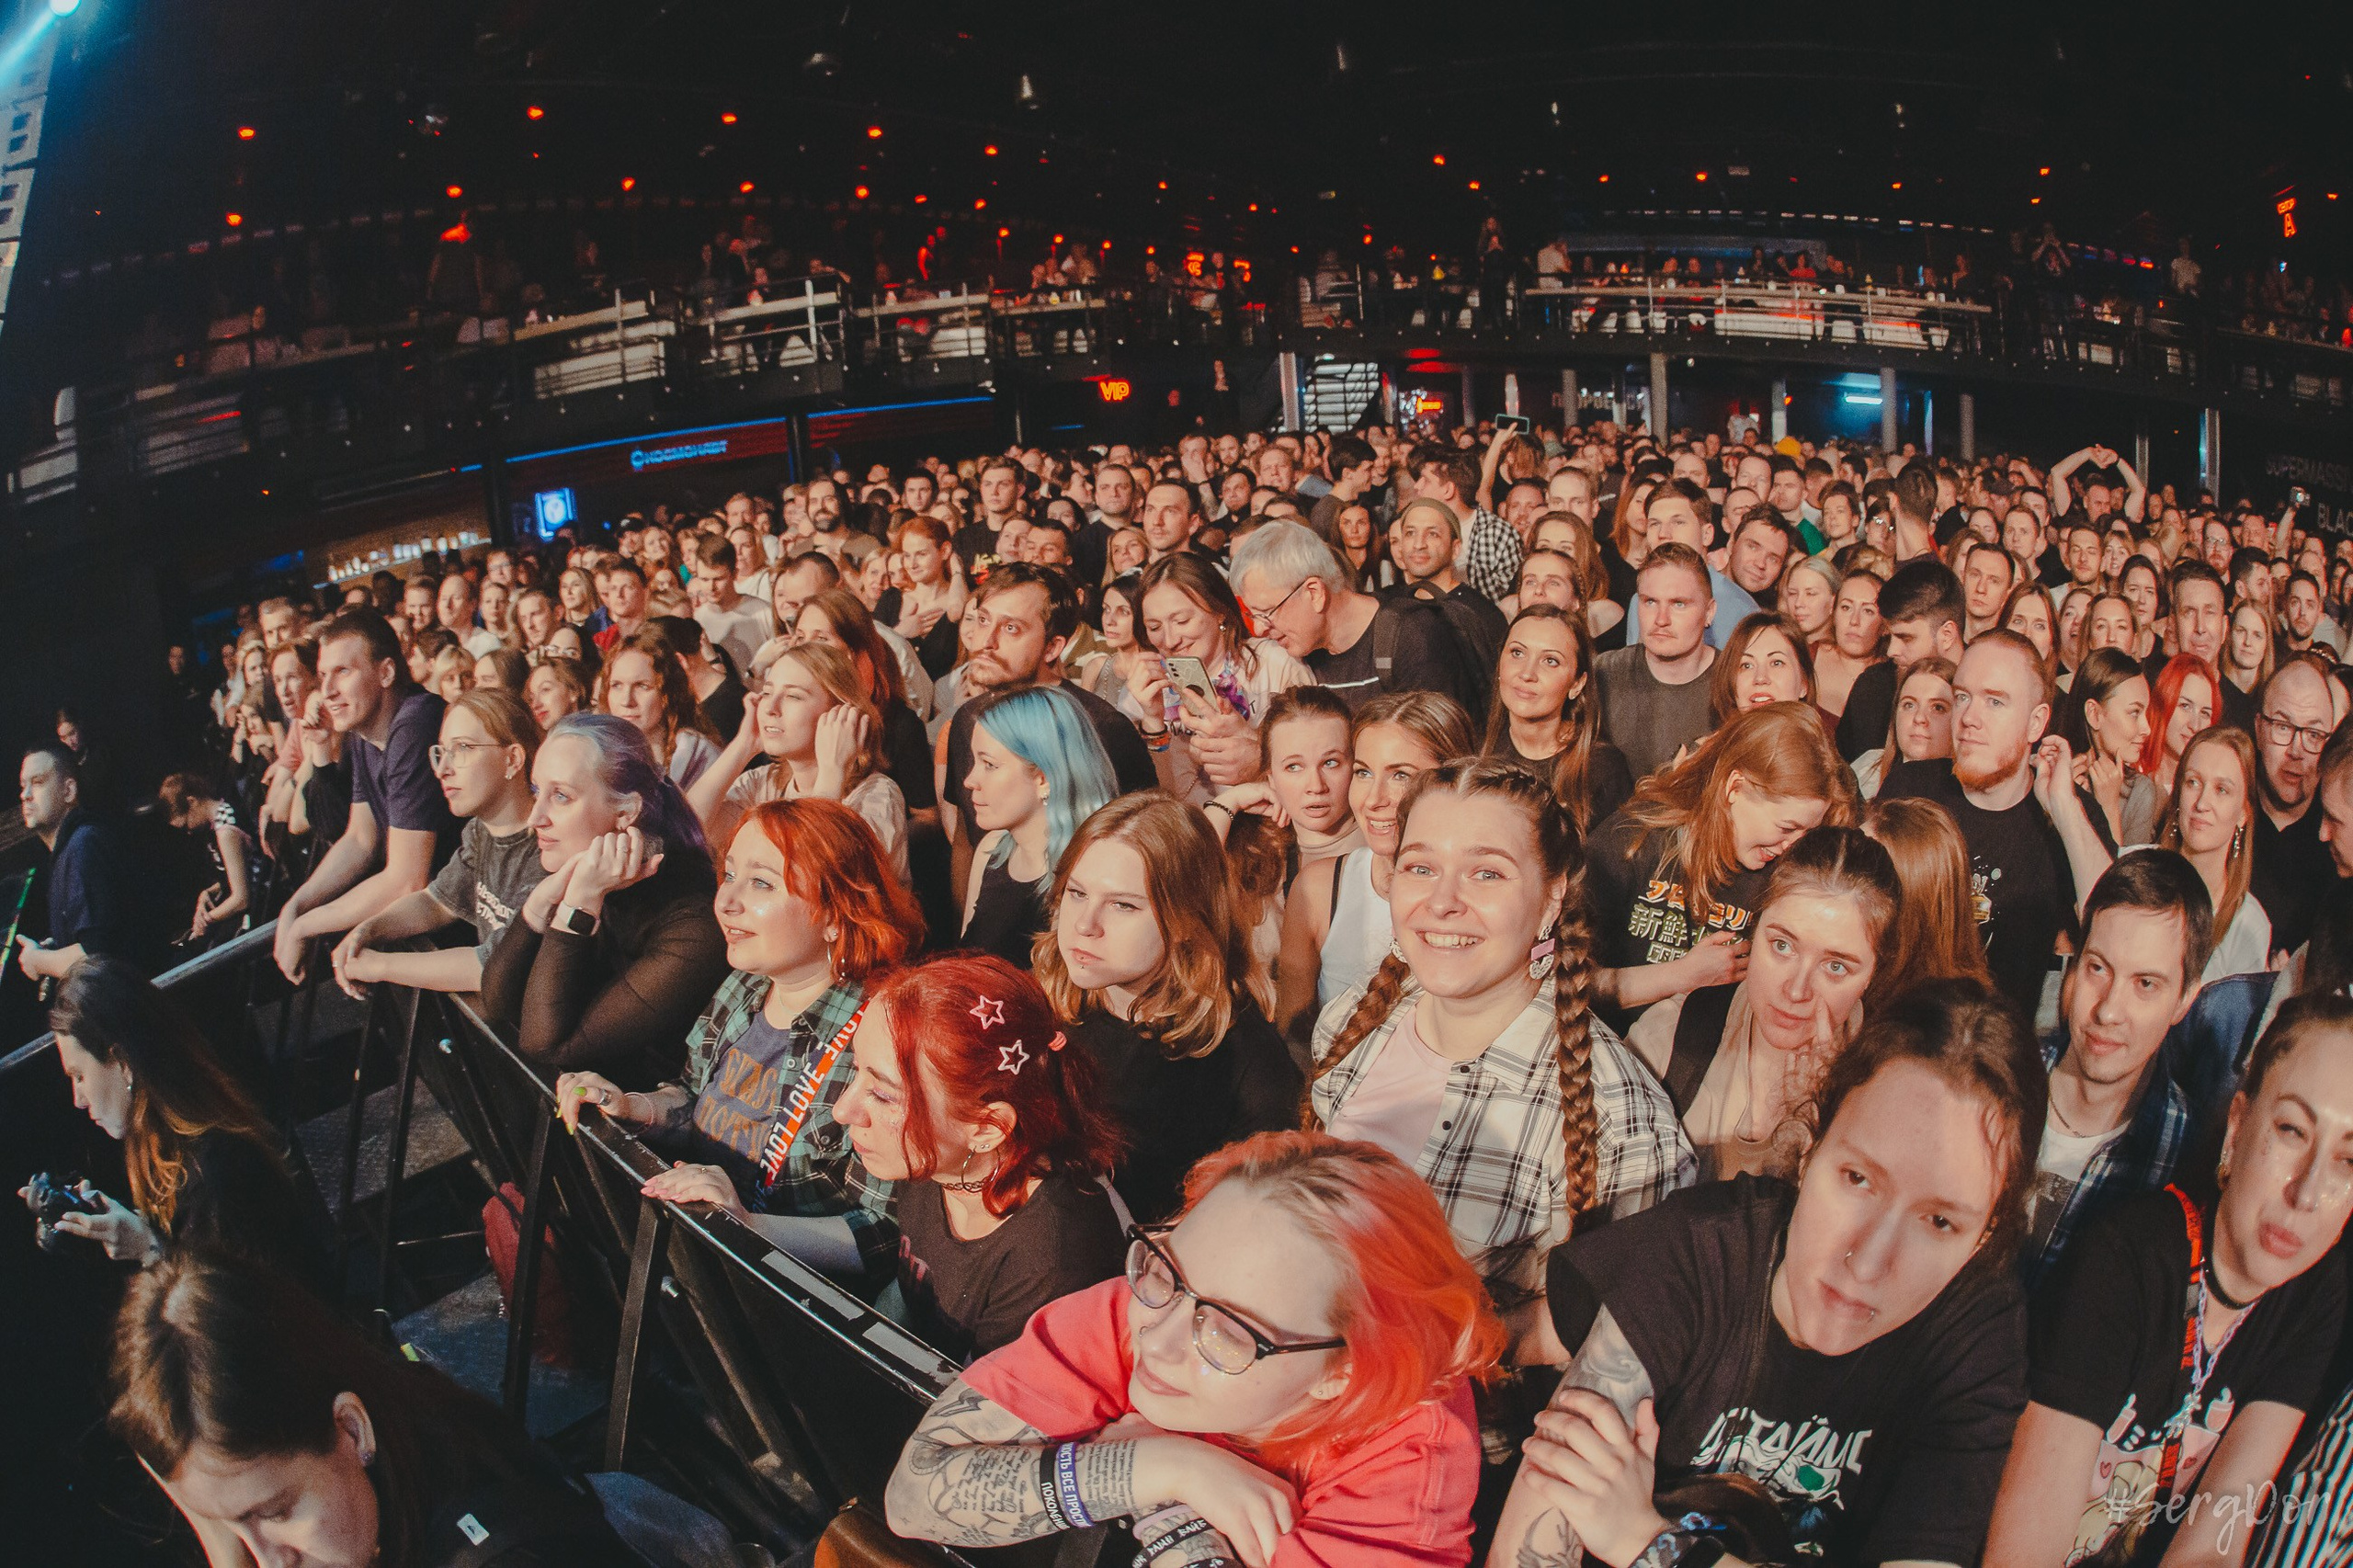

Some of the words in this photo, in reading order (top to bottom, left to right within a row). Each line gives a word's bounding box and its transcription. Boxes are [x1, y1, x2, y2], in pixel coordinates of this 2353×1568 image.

[1098, 380, 1131, 402] VIP
[782, 1062, 824, 1124] LOVE
[760, 1121, 794, 1181] LOVE
[1061, 1471, 1075, 1493] ВСЕ
